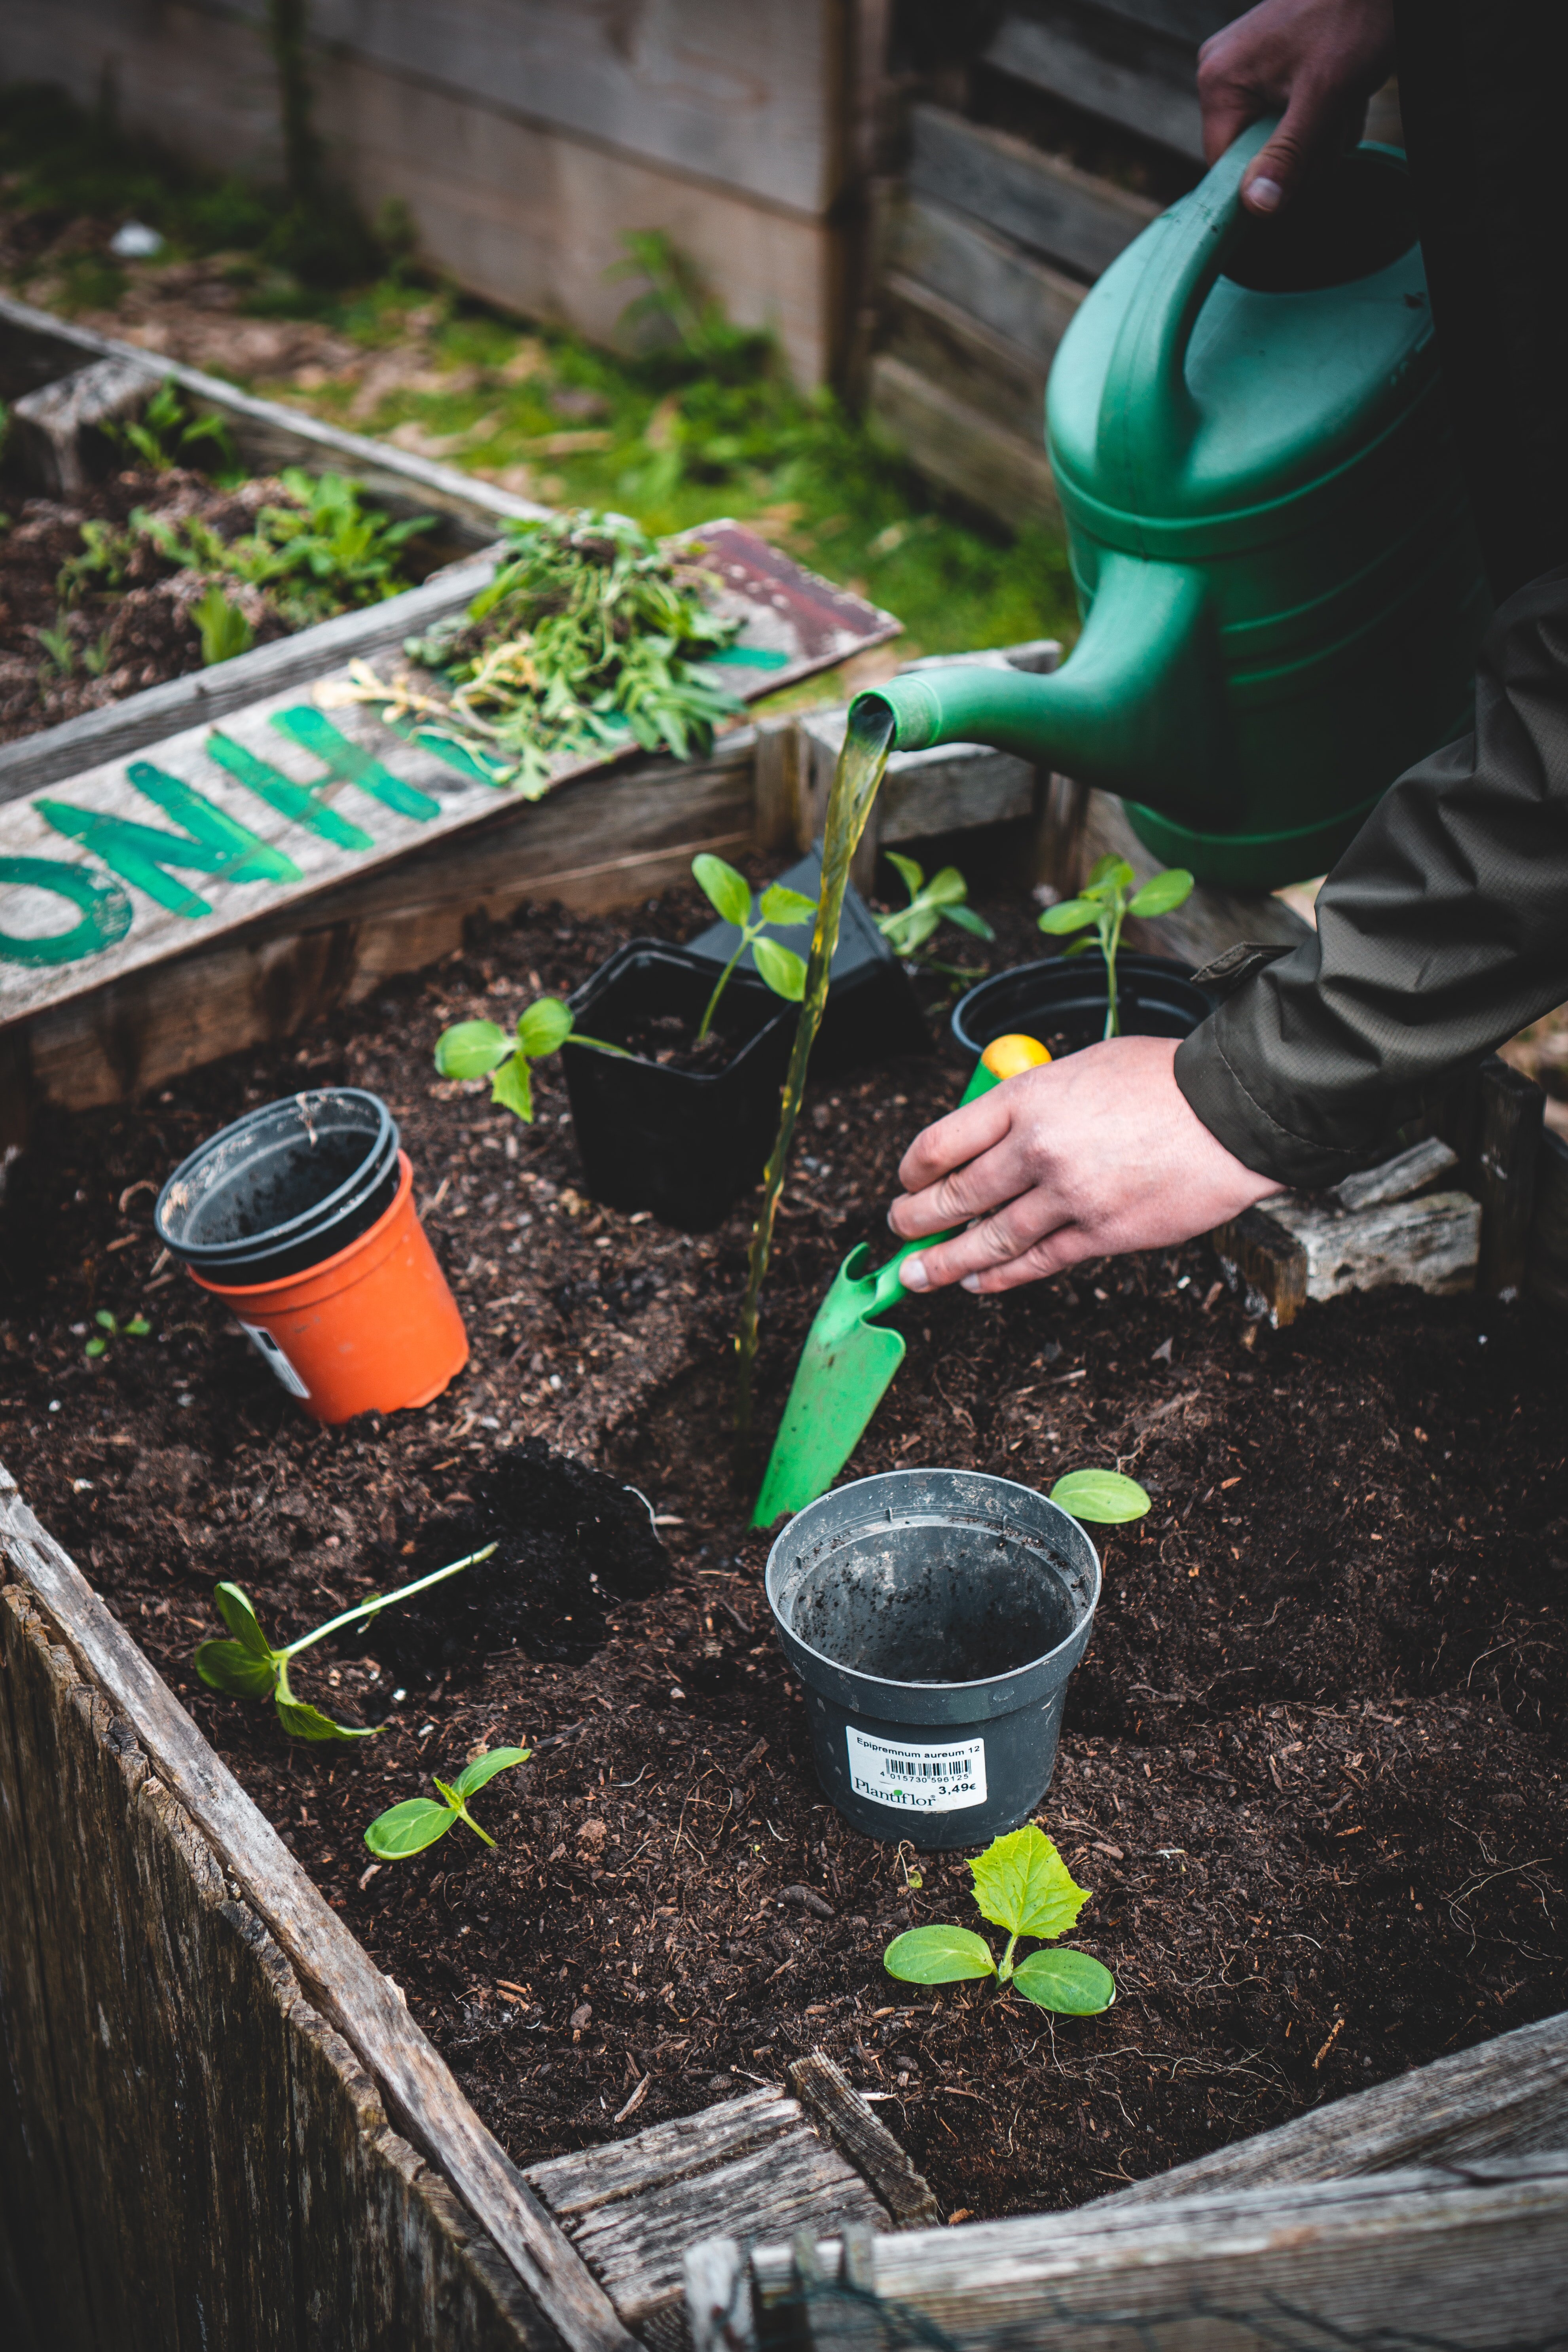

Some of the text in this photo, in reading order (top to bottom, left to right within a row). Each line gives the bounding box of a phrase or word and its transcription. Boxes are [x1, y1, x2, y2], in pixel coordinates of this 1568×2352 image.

[857, 1737, 920, 1758] Epipremnum
[890, 1773, 927, 1783] 015730
[931, 1773, 969, 1783] 596125
[854, 1776, 936, 1806] Plantiflor
[938, 1783, 976, 1795] 3,49€
